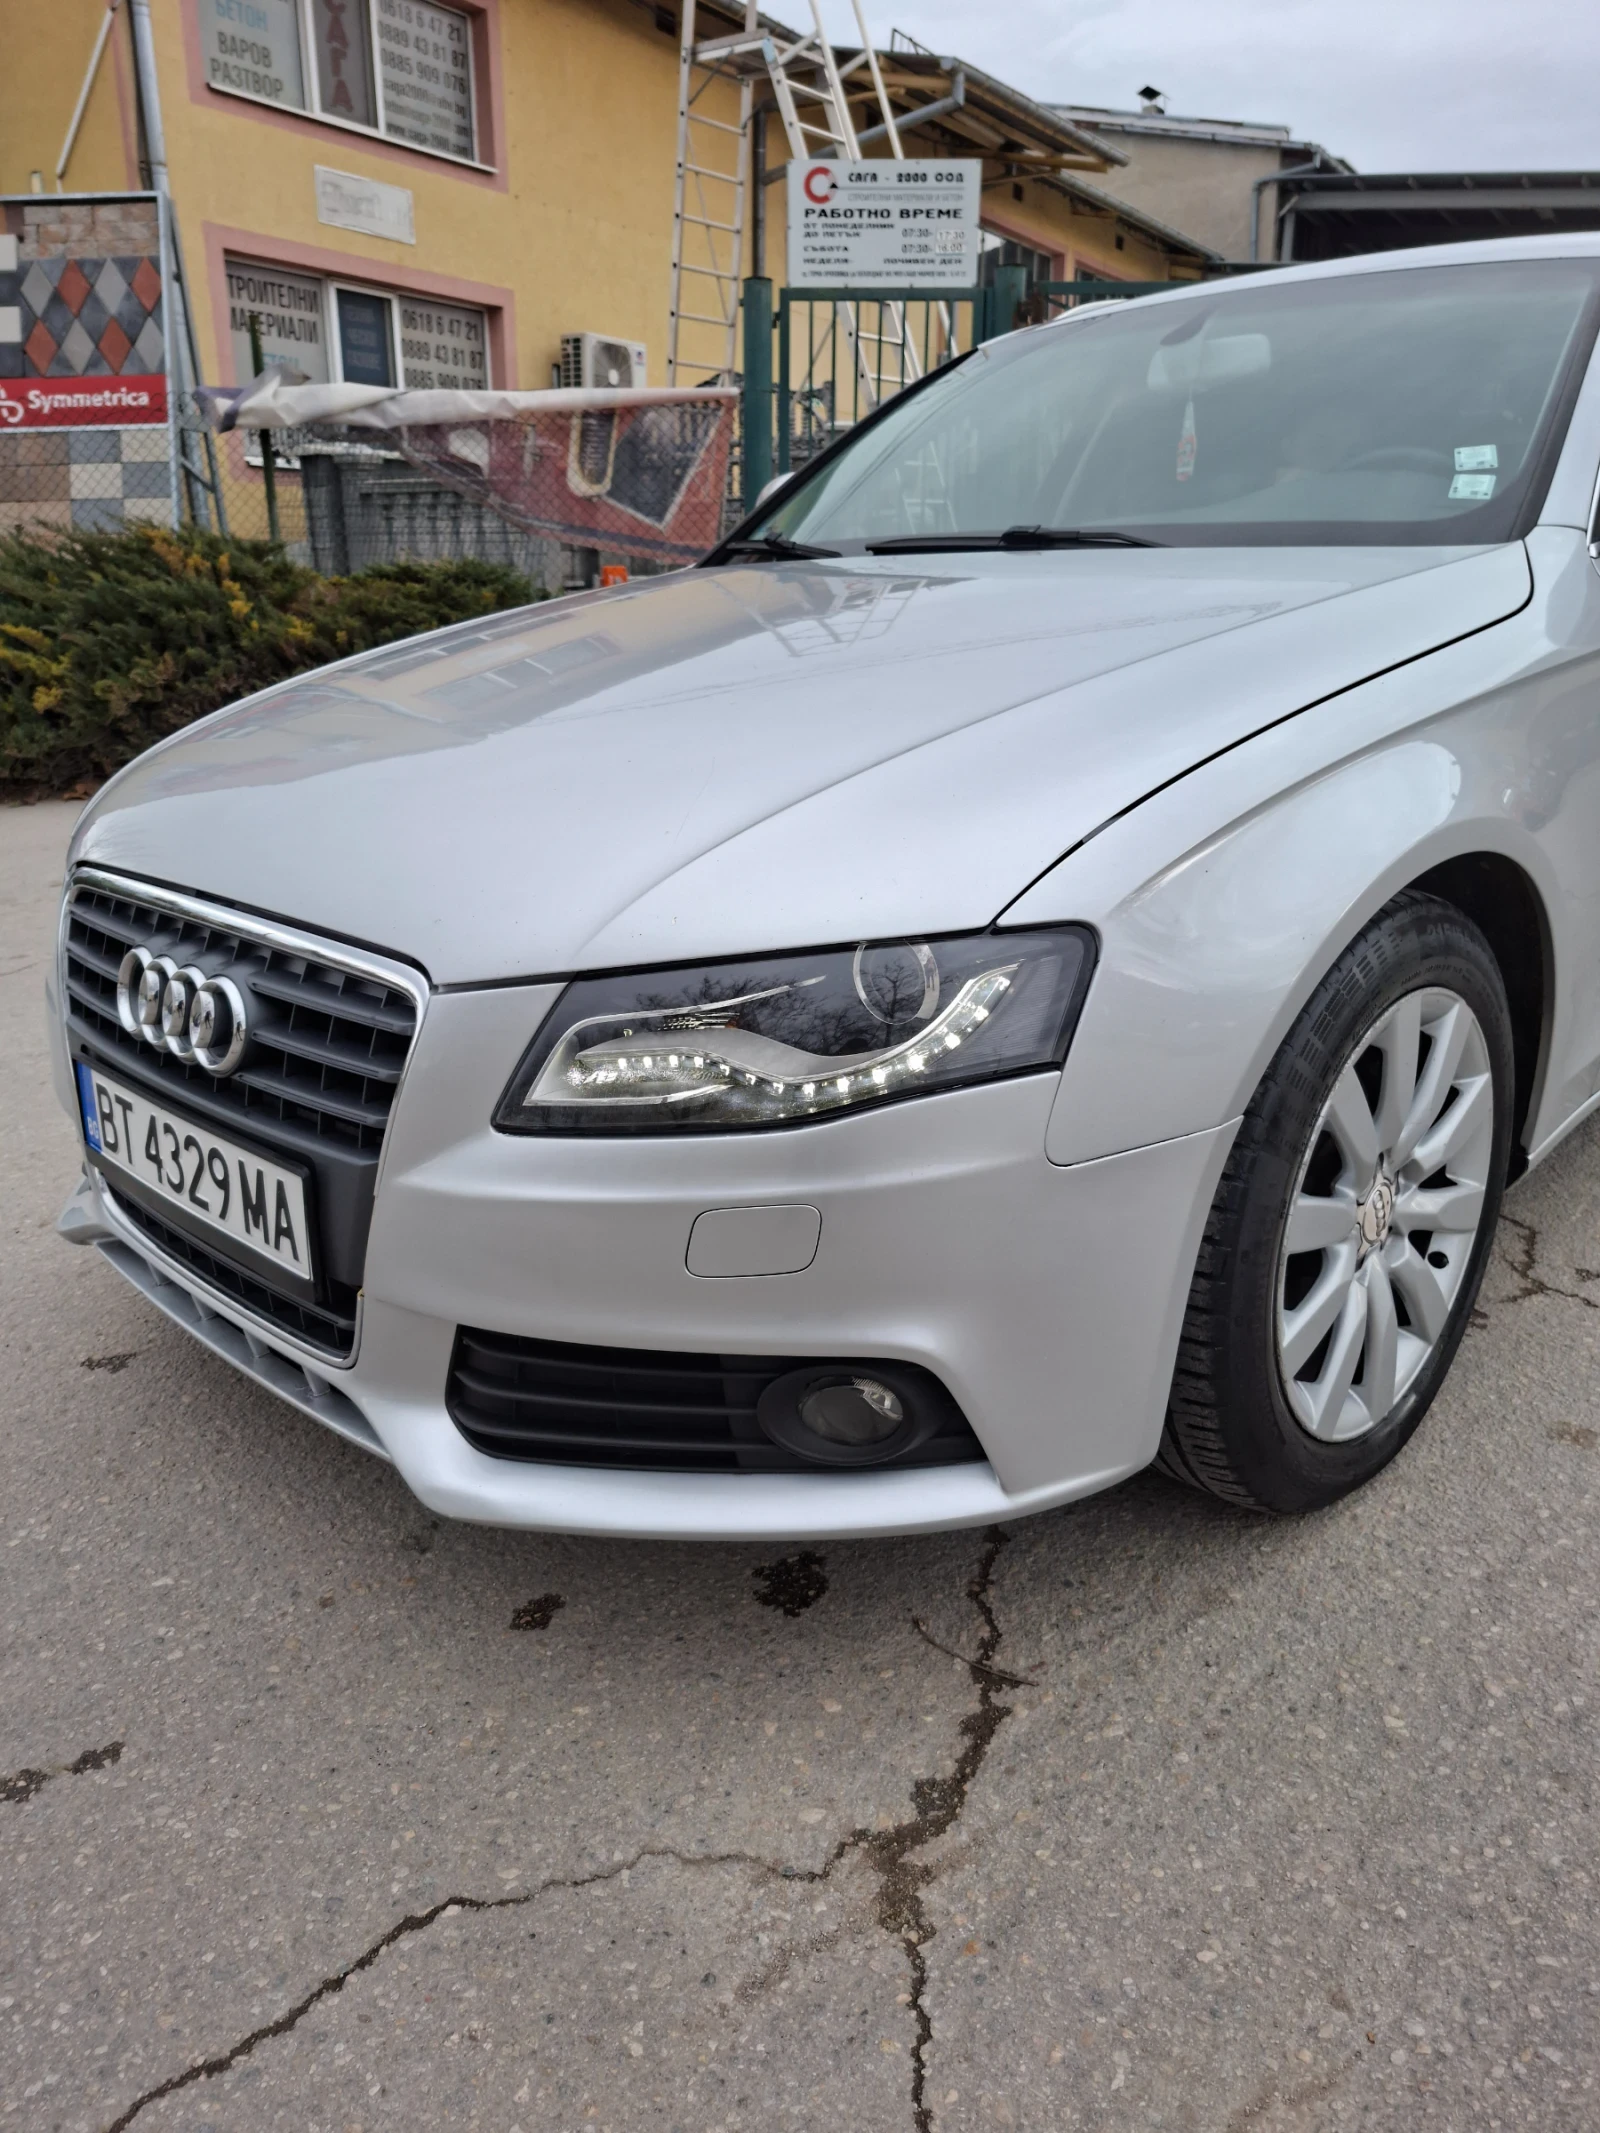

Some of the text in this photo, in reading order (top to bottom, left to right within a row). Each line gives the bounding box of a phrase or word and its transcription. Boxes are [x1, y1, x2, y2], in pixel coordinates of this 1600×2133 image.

[428, 16, 443, 36] 47
[447, 23, 462, 44] 21
[216, 30, 272, 68] ВАРОВ
[209, 58, 284, 99] РАЗТВОР
[416, 61, 440, 84] 909
[848, 171, 878, 184] САГА
[896, 171, 928, 184] 2000
[934, 171, 964, 184] ООД
[804, 208, 963, 219] РАБОТНО ВРЕМЕ
[803, 231, 819, 239] ДО
[803, 245, 849, 253] СЪБОТА
[939, 258, 963, 266] ДЕН
[402, 308, 480, 341] 0618 6 47 21
[435, 344, 449, 365] 43
[451, 347, 466, 367] 81
[469, 350, 484, 371] 87
[28, 388, 149, 414] Symmetrica
[87, 1115, 99, 1139] BG
[95, 1082, 300, 1262] BT 4329 MA
